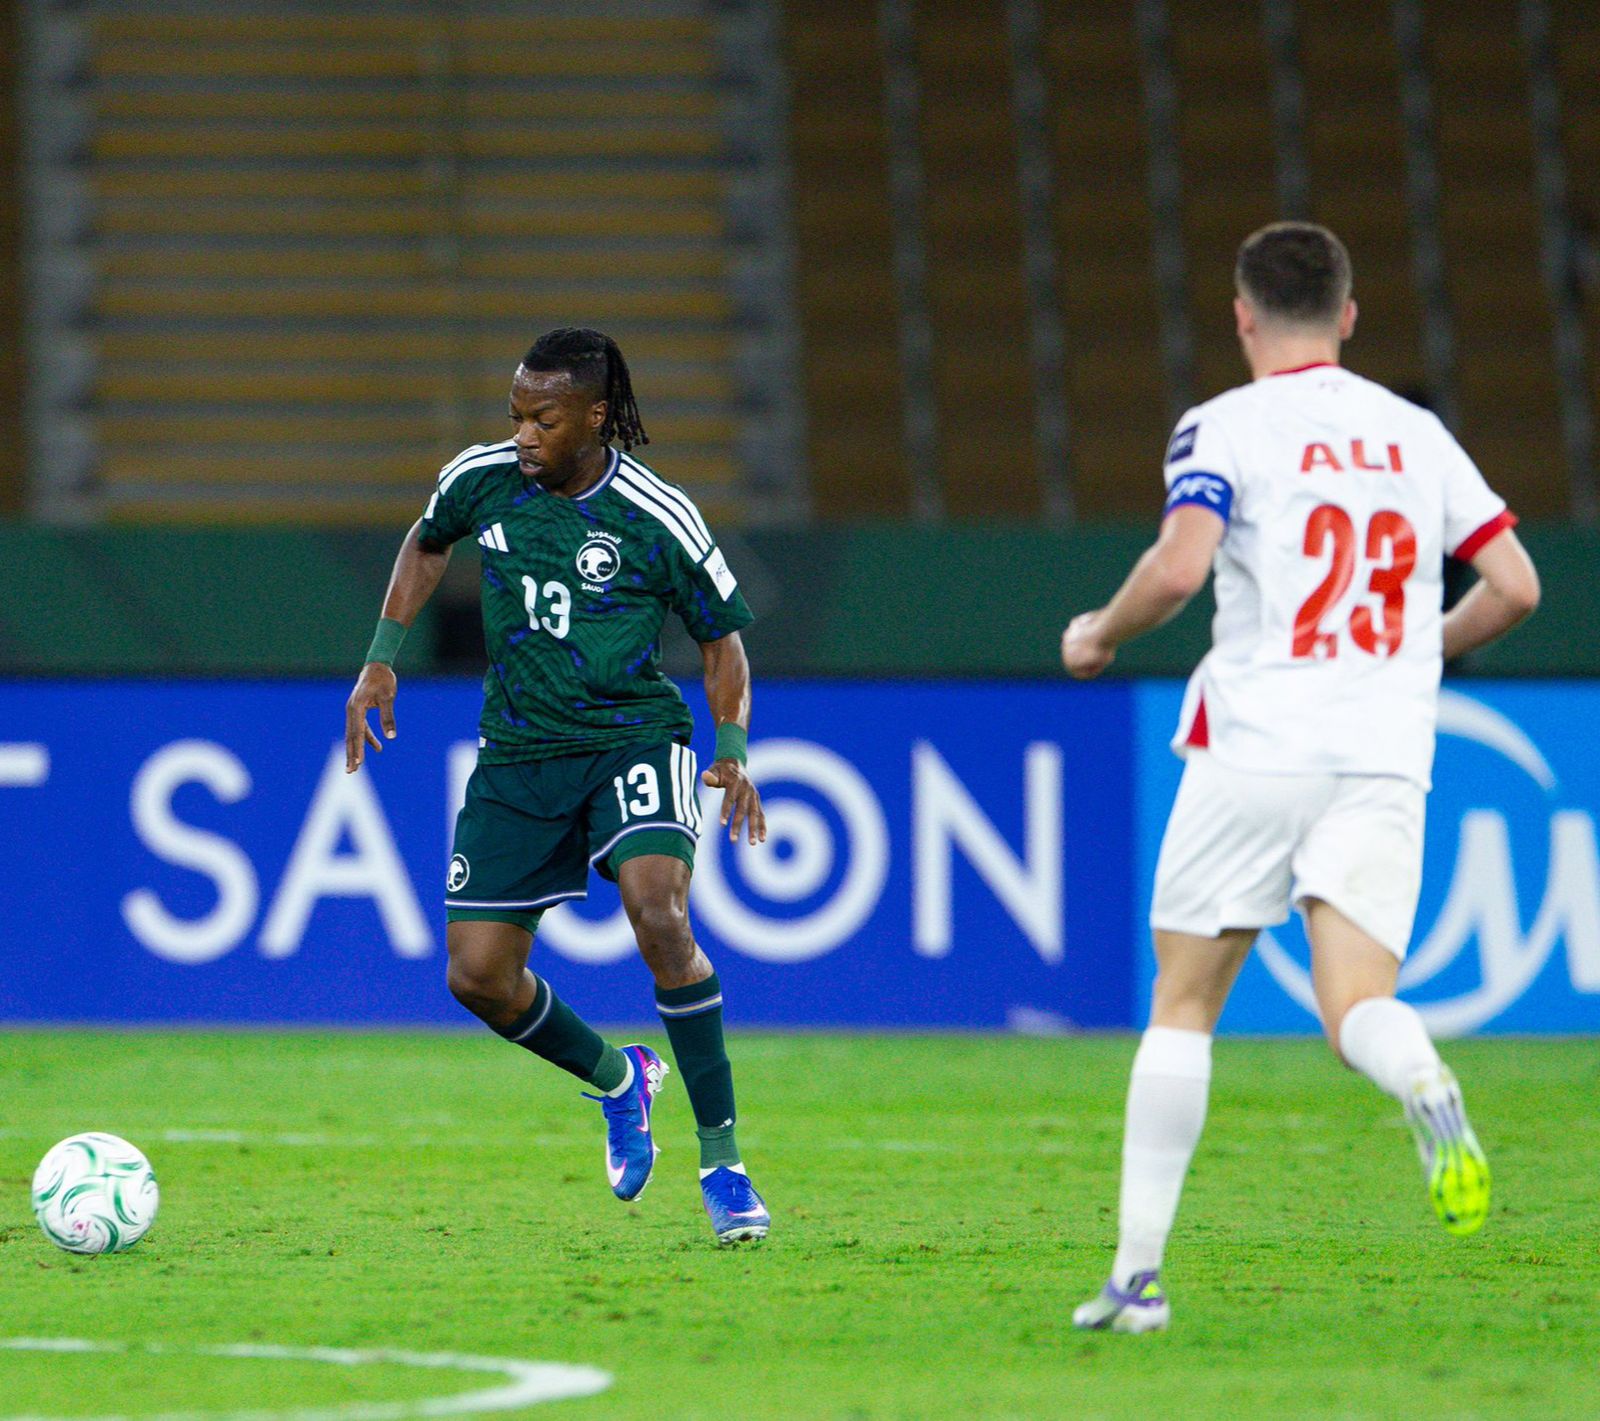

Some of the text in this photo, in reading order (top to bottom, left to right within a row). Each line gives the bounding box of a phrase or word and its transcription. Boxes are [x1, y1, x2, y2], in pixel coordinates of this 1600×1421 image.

[1300, 439, 1404, 473] ALI
[521, 575, 572, 639] 13
[581, 583, 605, 593] SAUDI
[1291, 504, 1418, 659] 23
[613, 763, 661, 823] 13
[120, 738, 1065, 966] SAON
